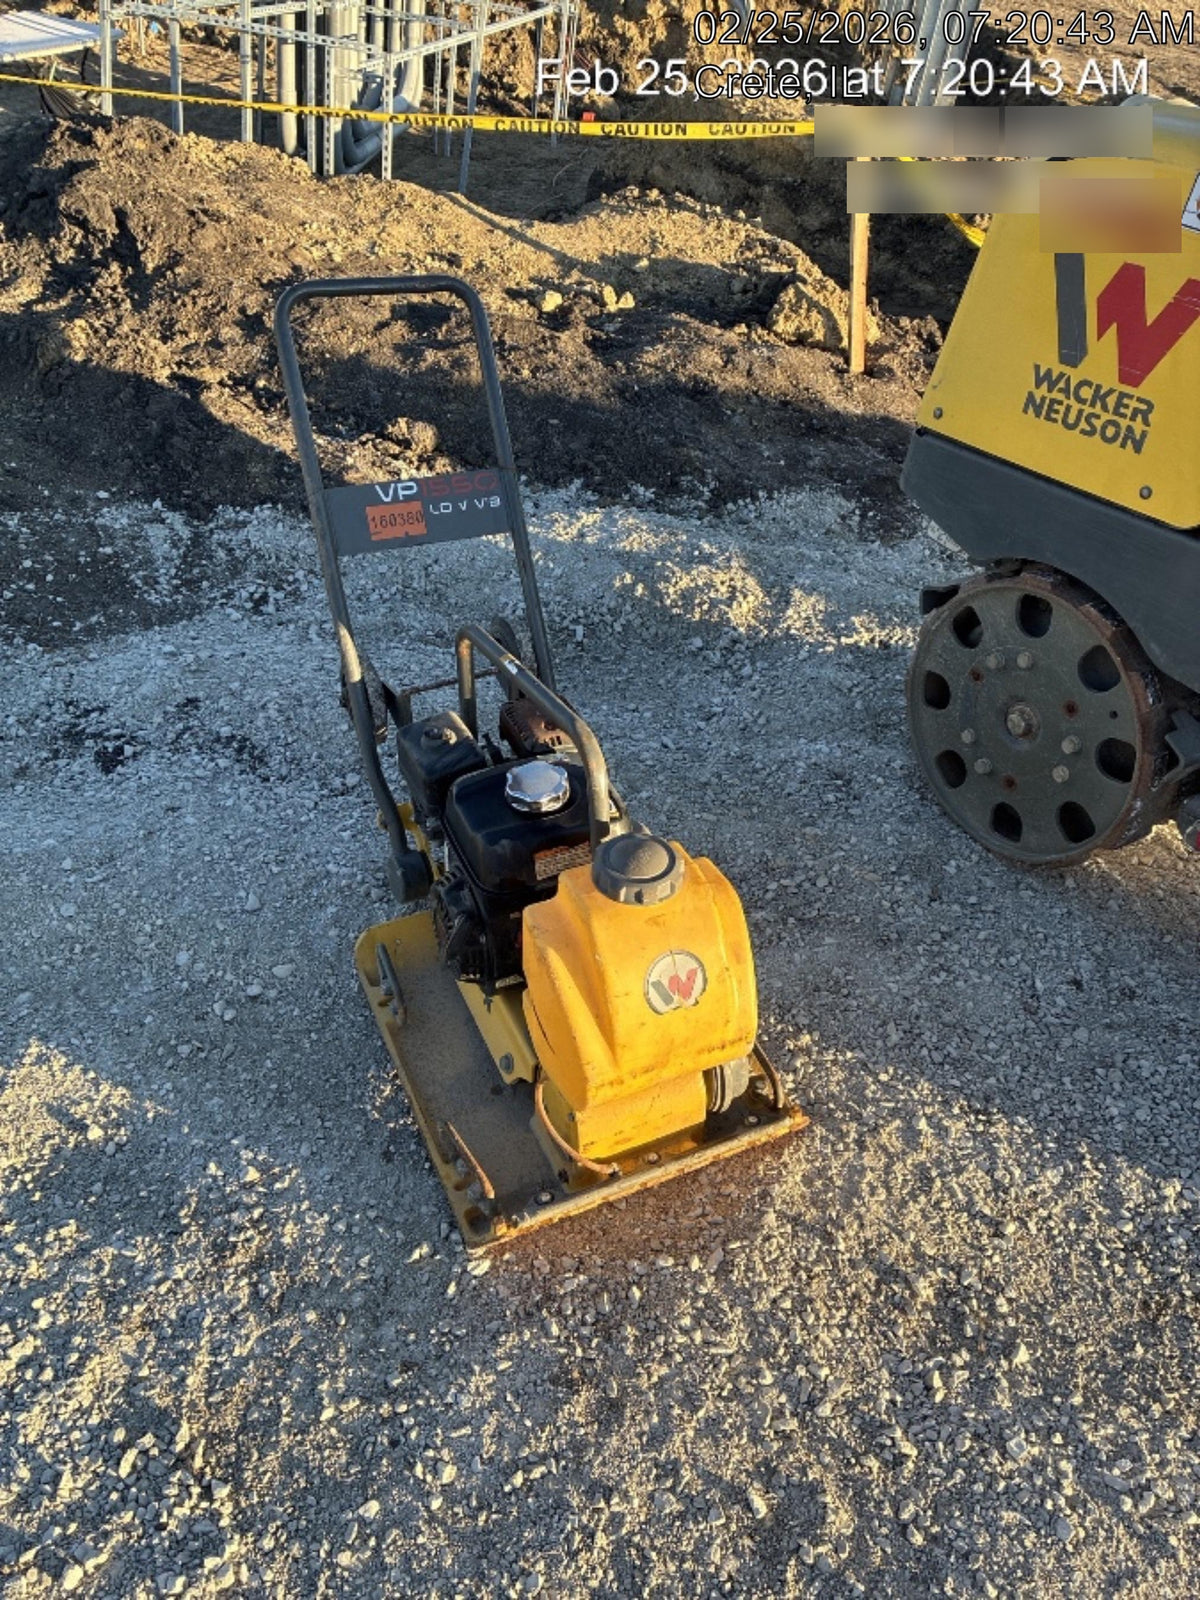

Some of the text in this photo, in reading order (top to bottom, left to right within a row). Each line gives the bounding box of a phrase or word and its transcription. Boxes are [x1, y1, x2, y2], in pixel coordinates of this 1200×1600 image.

[494, 119, 580, 135] CAUTION
[601, 123, 688, 136] CAUTION
[708, 123, 796, 136] CAUTION
[1022, 391, 1149, 455] NEUSON
[1033, 363, 1155, 427] WACKER
